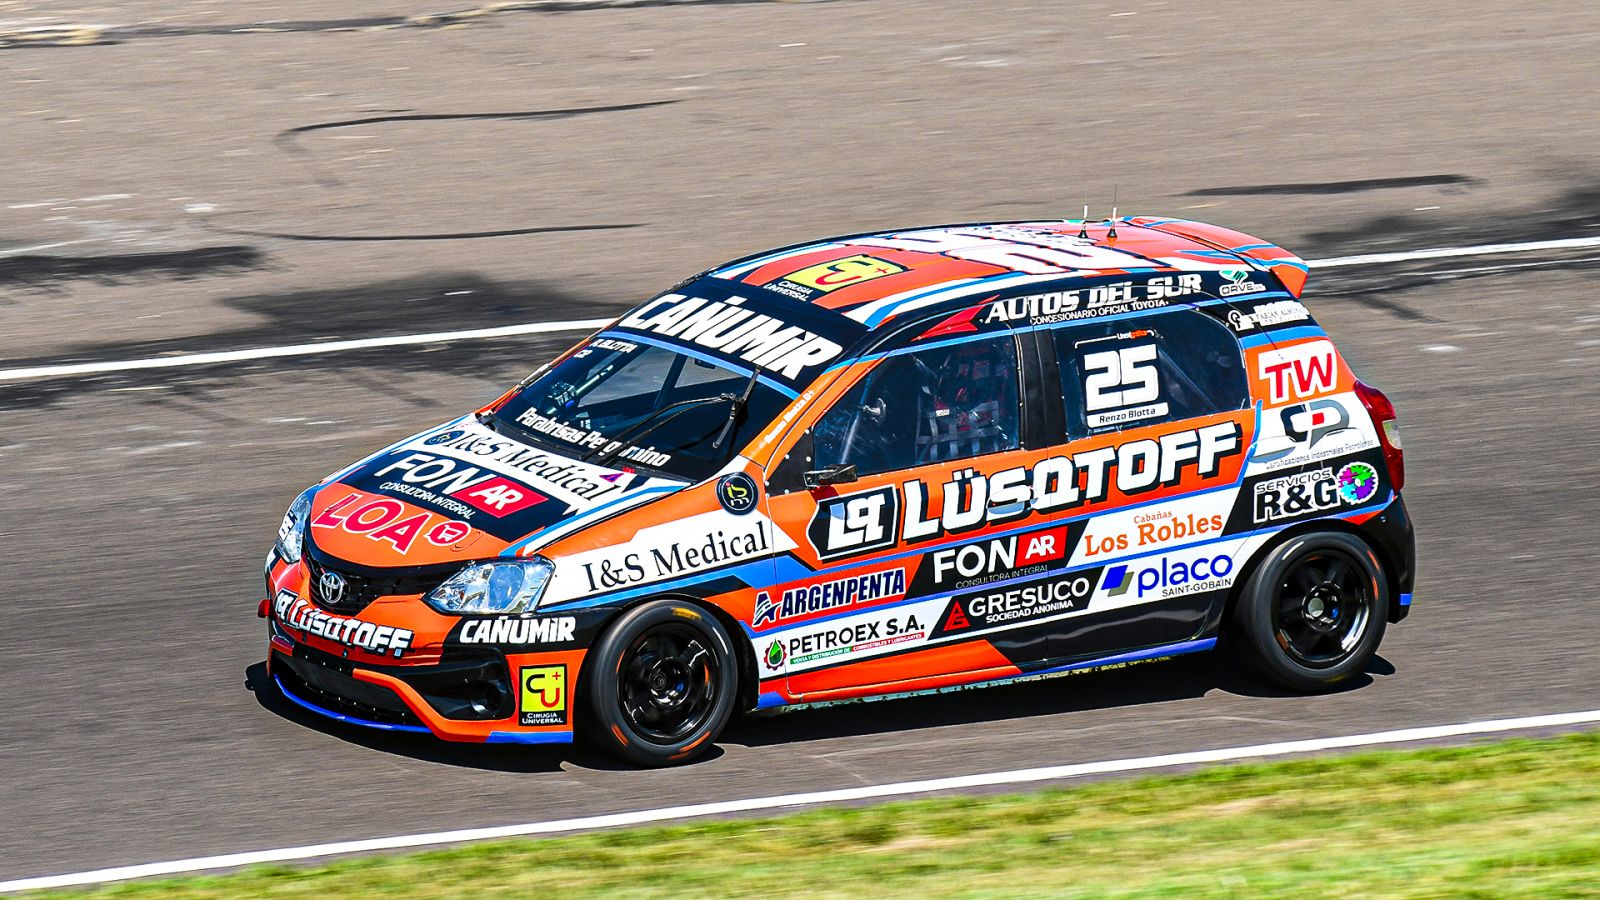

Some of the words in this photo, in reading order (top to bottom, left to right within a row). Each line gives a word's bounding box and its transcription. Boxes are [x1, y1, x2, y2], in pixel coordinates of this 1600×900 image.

[985, 291, 1080, 323] AUTOS
[1087, 281, 1139, 309] DEL
[1147, 273, 1203, 300] SUR
[1221, 283, 1254, 295] ORVE
[1030, 308, 1097, 325] CONCESIONARIO
[1098, 304, 1131, 316] OFICIAL
[1084, 344, 1159, 411] 25
[1265, 353, 1333, 398] TW
[515, 406, 587, 444] Parabrisas
[579, 430, 672, 467] Pegmino
[1099, 414, 1127, 424] Renzo
[1128, 408, 1156, 419] Blotta
[373, 452, 498, 495] FON
[469, 484, 524, 511] AR
[445, 432, 514, 456] I&S
[494, 447, 622, 503] Medical
[1256, 471, 1331, 494] SERVICIOS
[432, 496, 477, 520] INTEGRAL
[1134, 510, 1173, 525] Cabañas
[1257, 479, 1338, 520] R&G
[311, 493, 433, 556] LOA
[1084, 533, 1129, 557] Los
[1137, 514, 1223, 547] Robles
[583, 552, 645, 593] I&S
[650, 520, 769, 577] Medical
[933, 536, 1017, 584] FON
[1024, 534, 1058, 560] AR
[1137, 554, 1233, 598] placo
[780, 568, 905, 618] ARGENPENTA
[955, 571, 1011, 590] CONSULTORA
[968, 576, 1090, 618] GRESUCO
[1161, 577, 1232, 599] SAINT-GOBAIN
[789, 621, 880, 655] PETROEX
[886, 614, 925, 636] S.A.
[986, 607, 1031, 624] SOCIEDAD
[522, 717, 564, 726] UNIVERSAL
[526, 711, 557, 720] CIRUGIA
